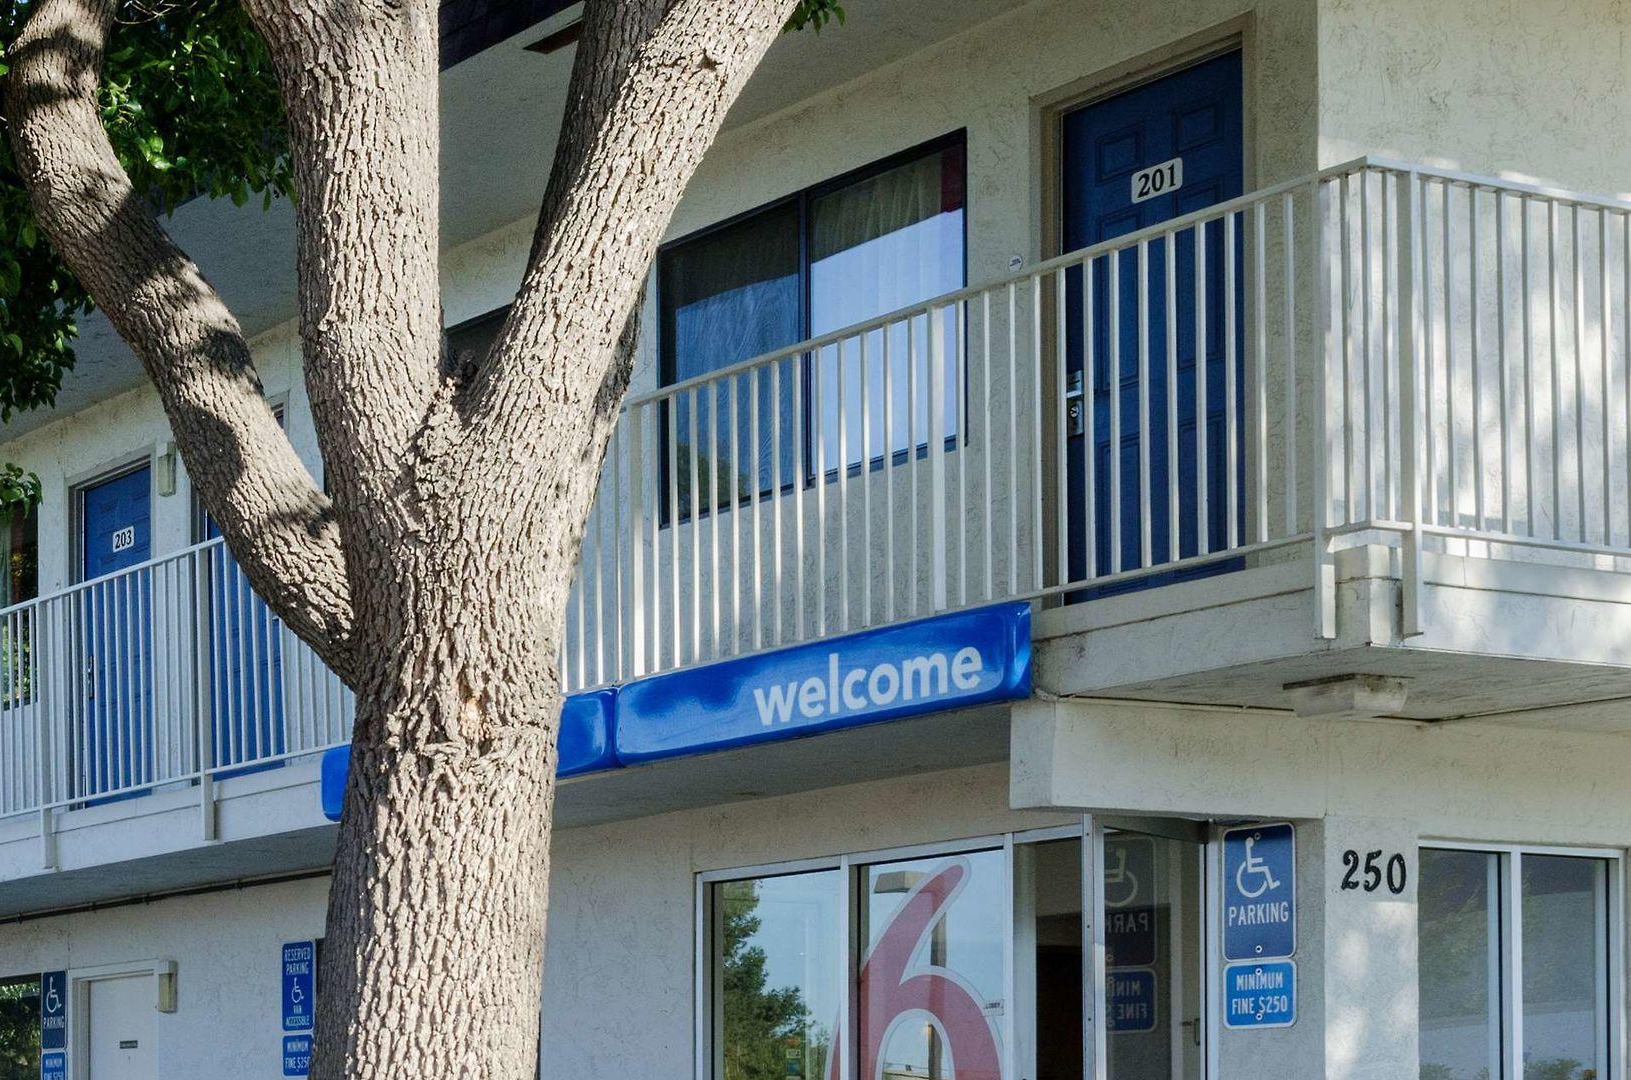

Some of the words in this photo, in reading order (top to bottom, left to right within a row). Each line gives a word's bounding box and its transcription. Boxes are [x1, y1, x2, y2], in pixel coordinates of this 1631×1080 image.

[1137, 163, 1177, 199] 201
[114, 529, 132, 550] 203
[753, 646, 984, 726] welcome
[1340, 849, 1407, 895] 250
[1228, 900, 1290, 927] PARKING
[284, 947, 311, 961] RESERVED
[286, 962, 309, 975] PARKING
[1235, 971, 1284, 992] MINIMUM
[1231, 996, 1255, 1016] FINE
[1259, 995, 1288, 1016] $250
[43, 1015, 65, 1030] PARKING
